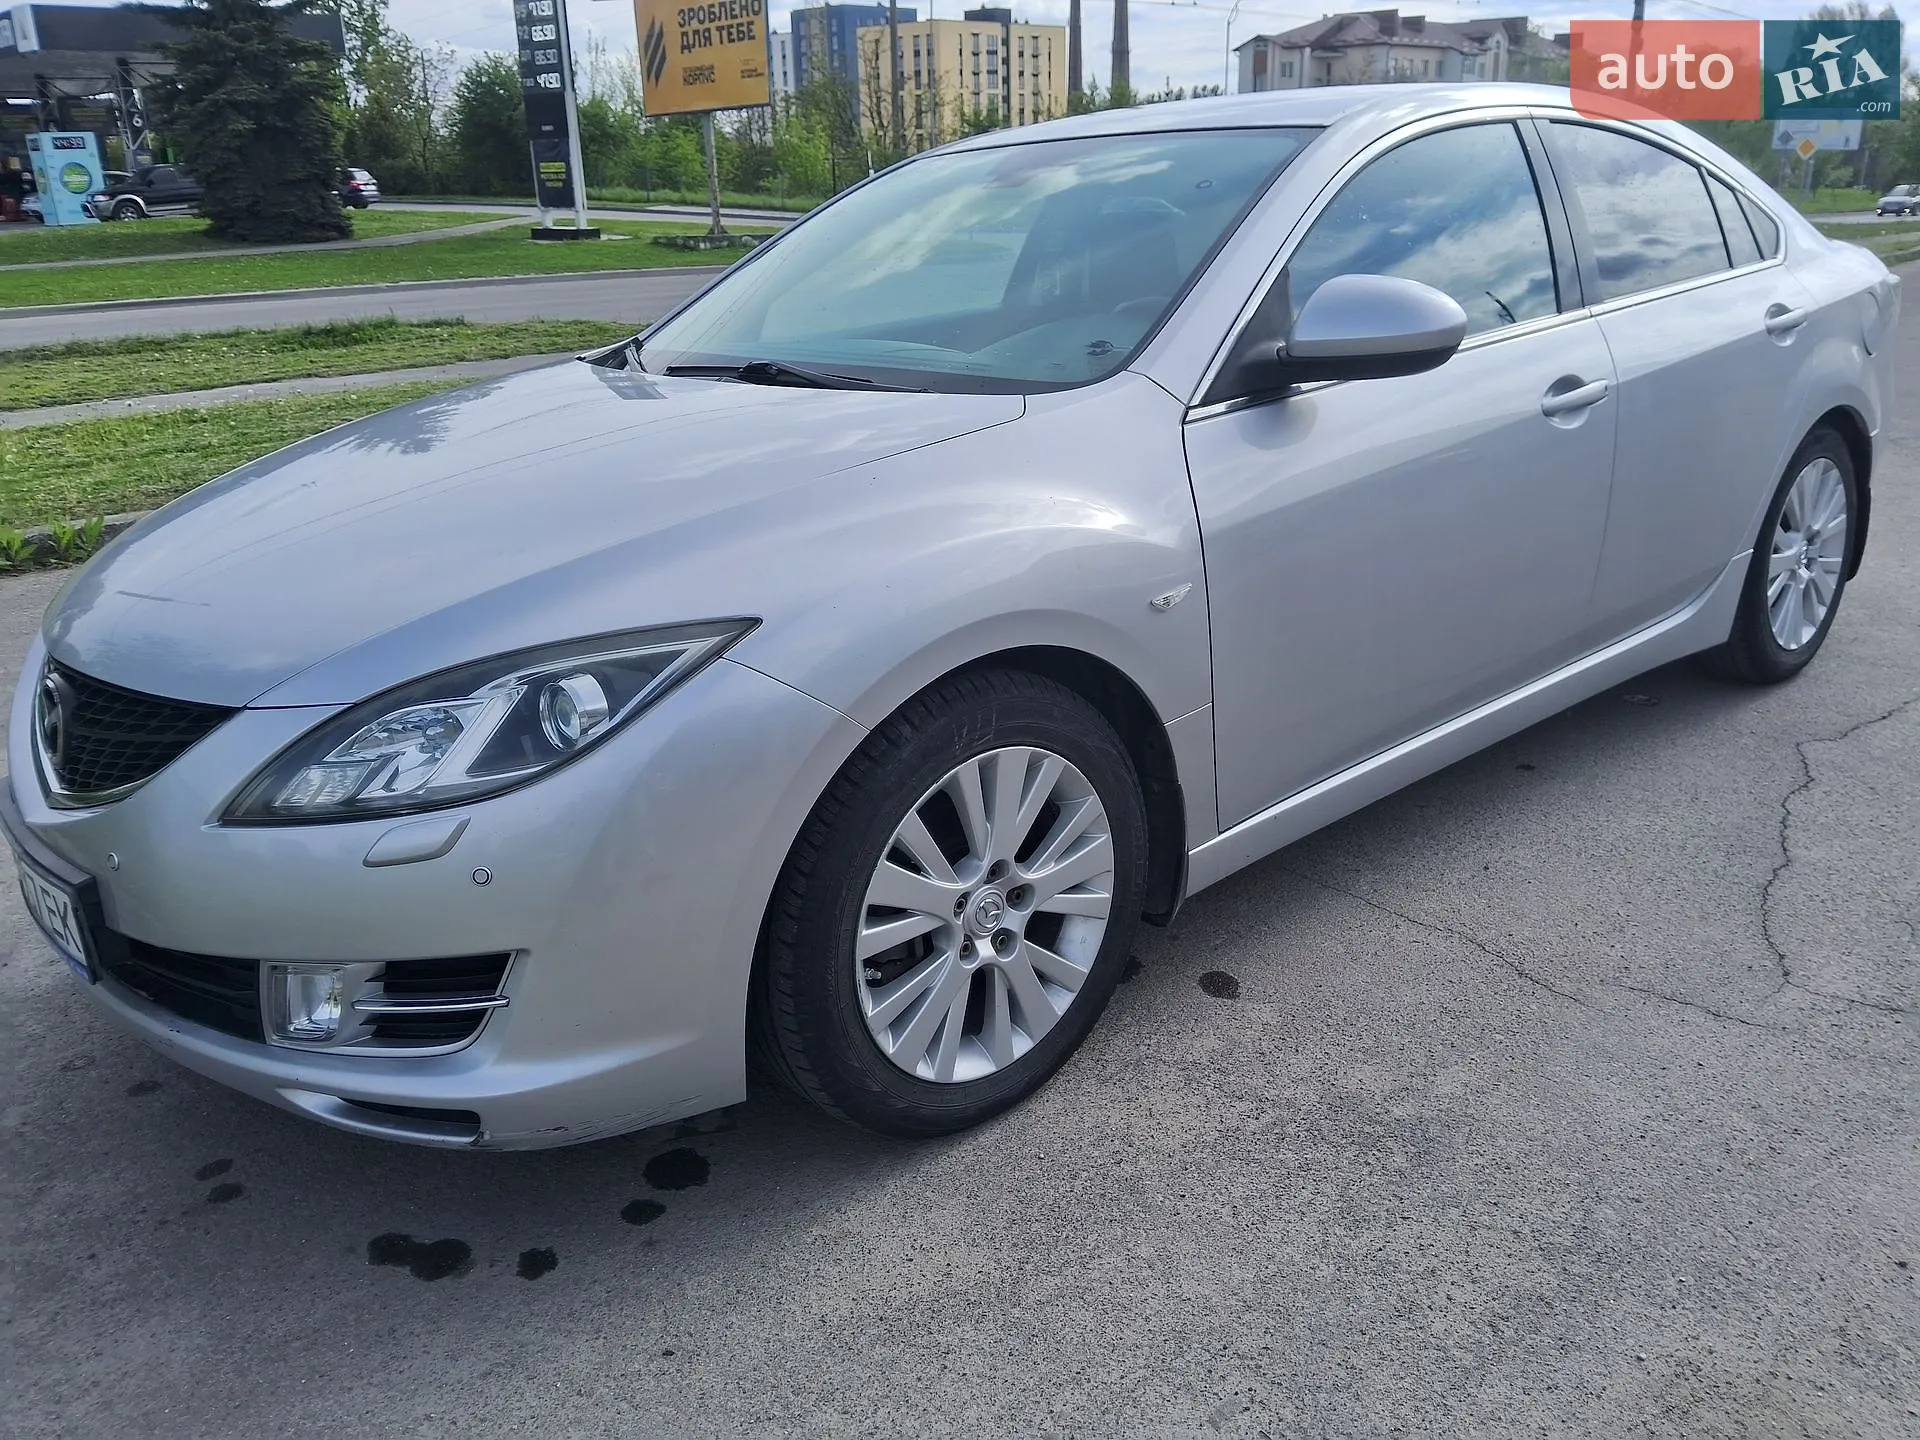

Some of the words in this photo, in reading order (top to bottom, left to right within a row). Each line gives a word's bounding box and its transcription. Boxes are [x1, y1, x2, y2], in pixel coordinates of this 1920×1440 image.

[677, 0, 762, 28] ЗРОБЛЕНО
[680, 28, 713, 54] ДЛЯ
[716, 20, 756, 45] ТЕБЕ
